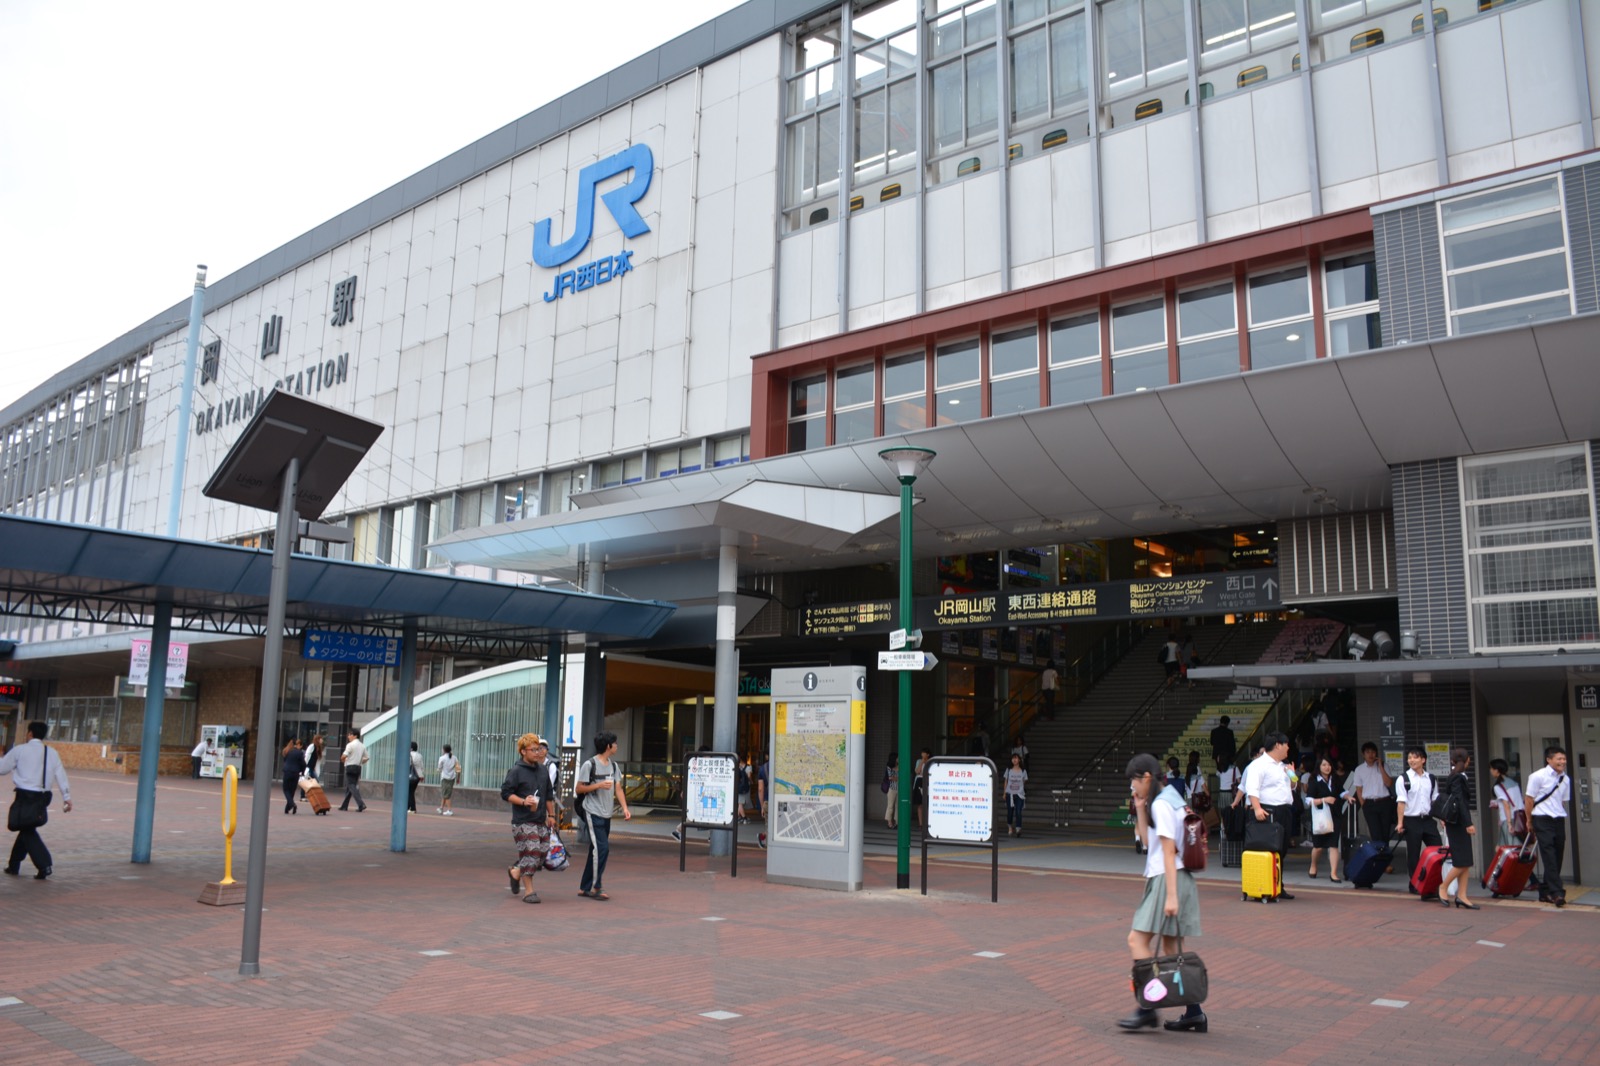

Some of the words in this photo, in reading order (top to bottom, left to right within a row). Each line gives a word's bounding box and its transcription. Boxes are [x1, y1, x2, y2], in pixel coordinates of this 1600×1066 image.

[532, 143, 654, 269] JR
[543, 250, 634, 303] JR西日本
[201, 275, 357, 386] 岡山駅
[196, 387, 265, 435] OKAYAMA
[1129, 579, 1213, 594] 岡山コンベンションセンター
[1226, 576, 1256, 591] 西口
[1008, 589, 1096, 610] 東西連絡通路
[1155, 589, 1184, 597] Convention
[1238, 591, 1256, 599] Gate
[934, 597, 996, 615] JR岡山駅
[1129, 595, 1204, 609] 岡山シティミュージアム
[1130, 607, 1155, 615] Okayama
[1155, 606, 1166, 614] City
[938, 616, 968, 626] Okayama
[969, 615, 992, 623] Station
[321, 634, 385, 649] バスのりば
[321, 647, 384, 662] タクシーのりば
[566, 715, 577, 744] 1
[948, 770, 973, 778] 禁止行為
